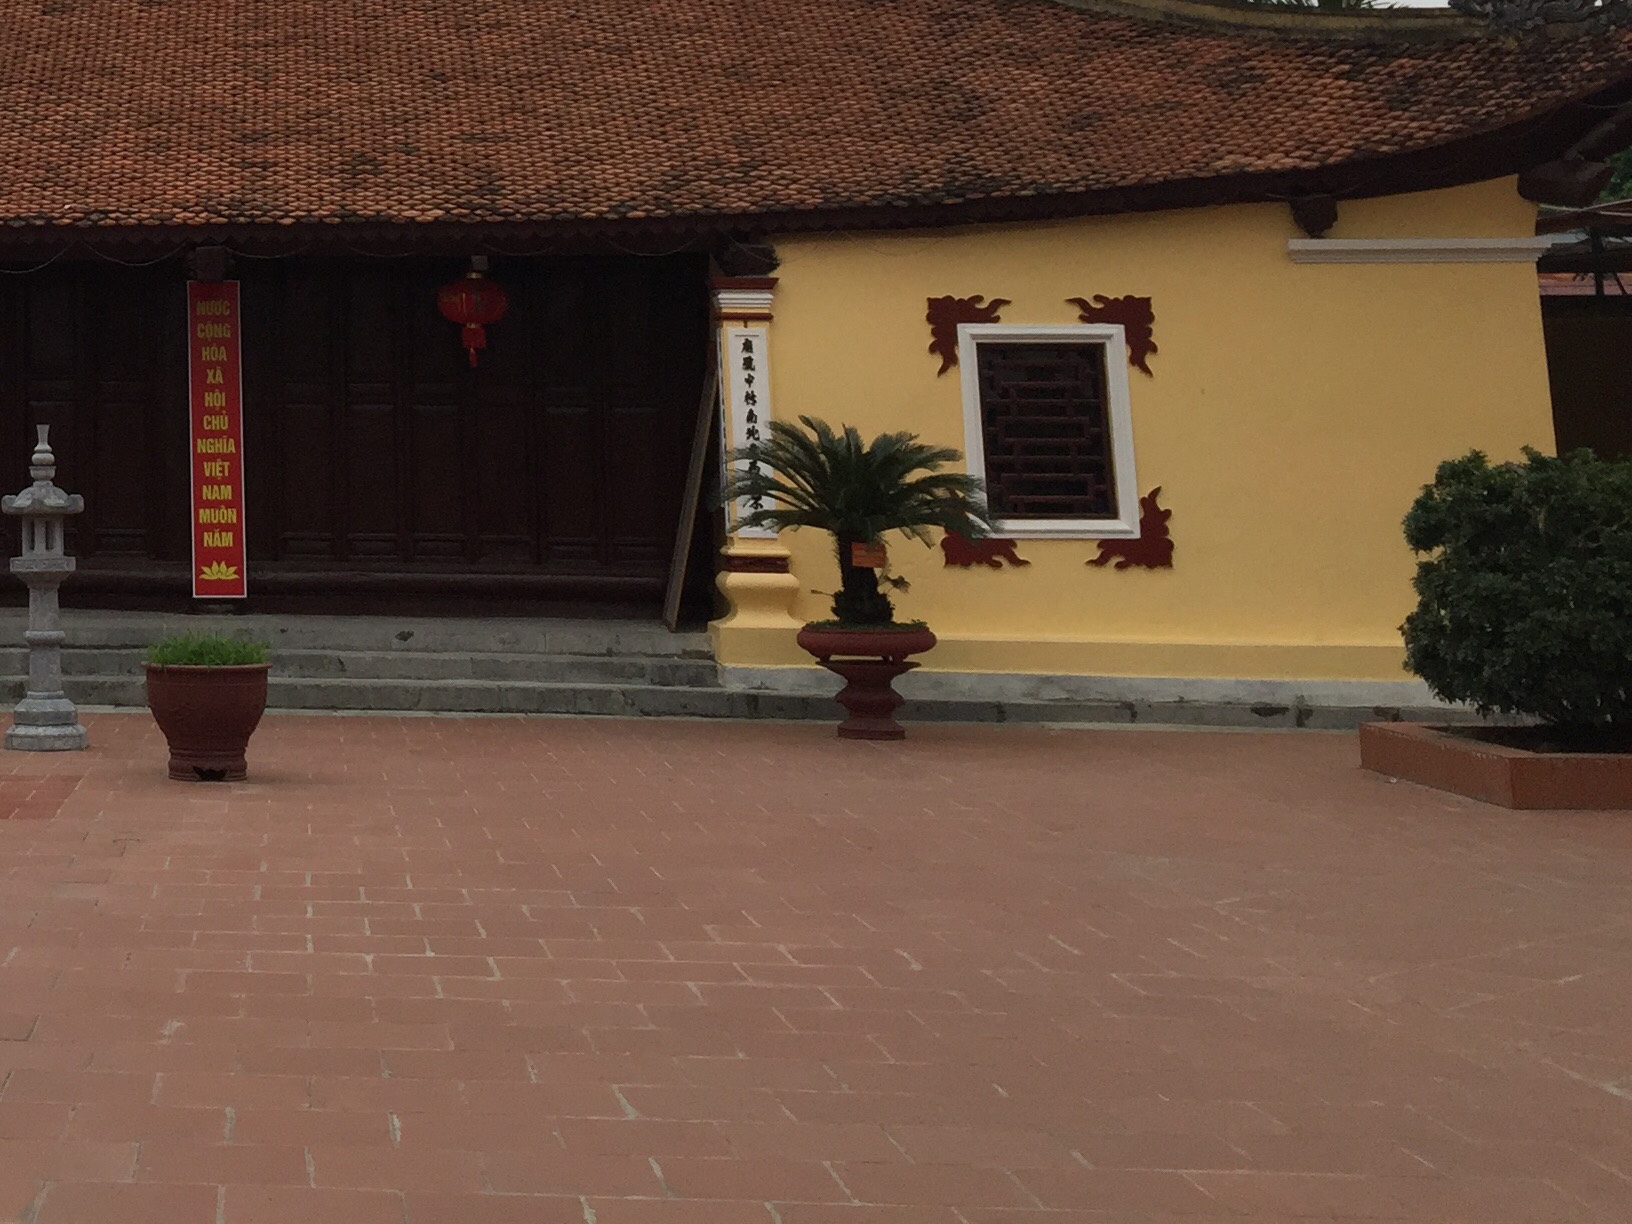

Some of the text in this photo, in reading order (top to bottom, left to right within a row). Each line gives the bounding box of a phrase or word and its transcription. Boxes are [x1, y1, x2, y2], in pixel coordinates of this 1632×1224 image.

[196, 298, 231, 316] NƯỚC
[196, 321, 231, 341] CỘNG
[206, 366, 224, 384] XÃ
[204, 388, 226, 411] HỘI
[203, 410, 229, 430] CHỦ
[197, 435, 236, 453] NGHĨA
[203, 458, 230, 480] VIỆT
[202, 484, 232, 500] NAM
[199, 505, 237, 523] MUÔN
[203, 528, 233, 547] NĂM
